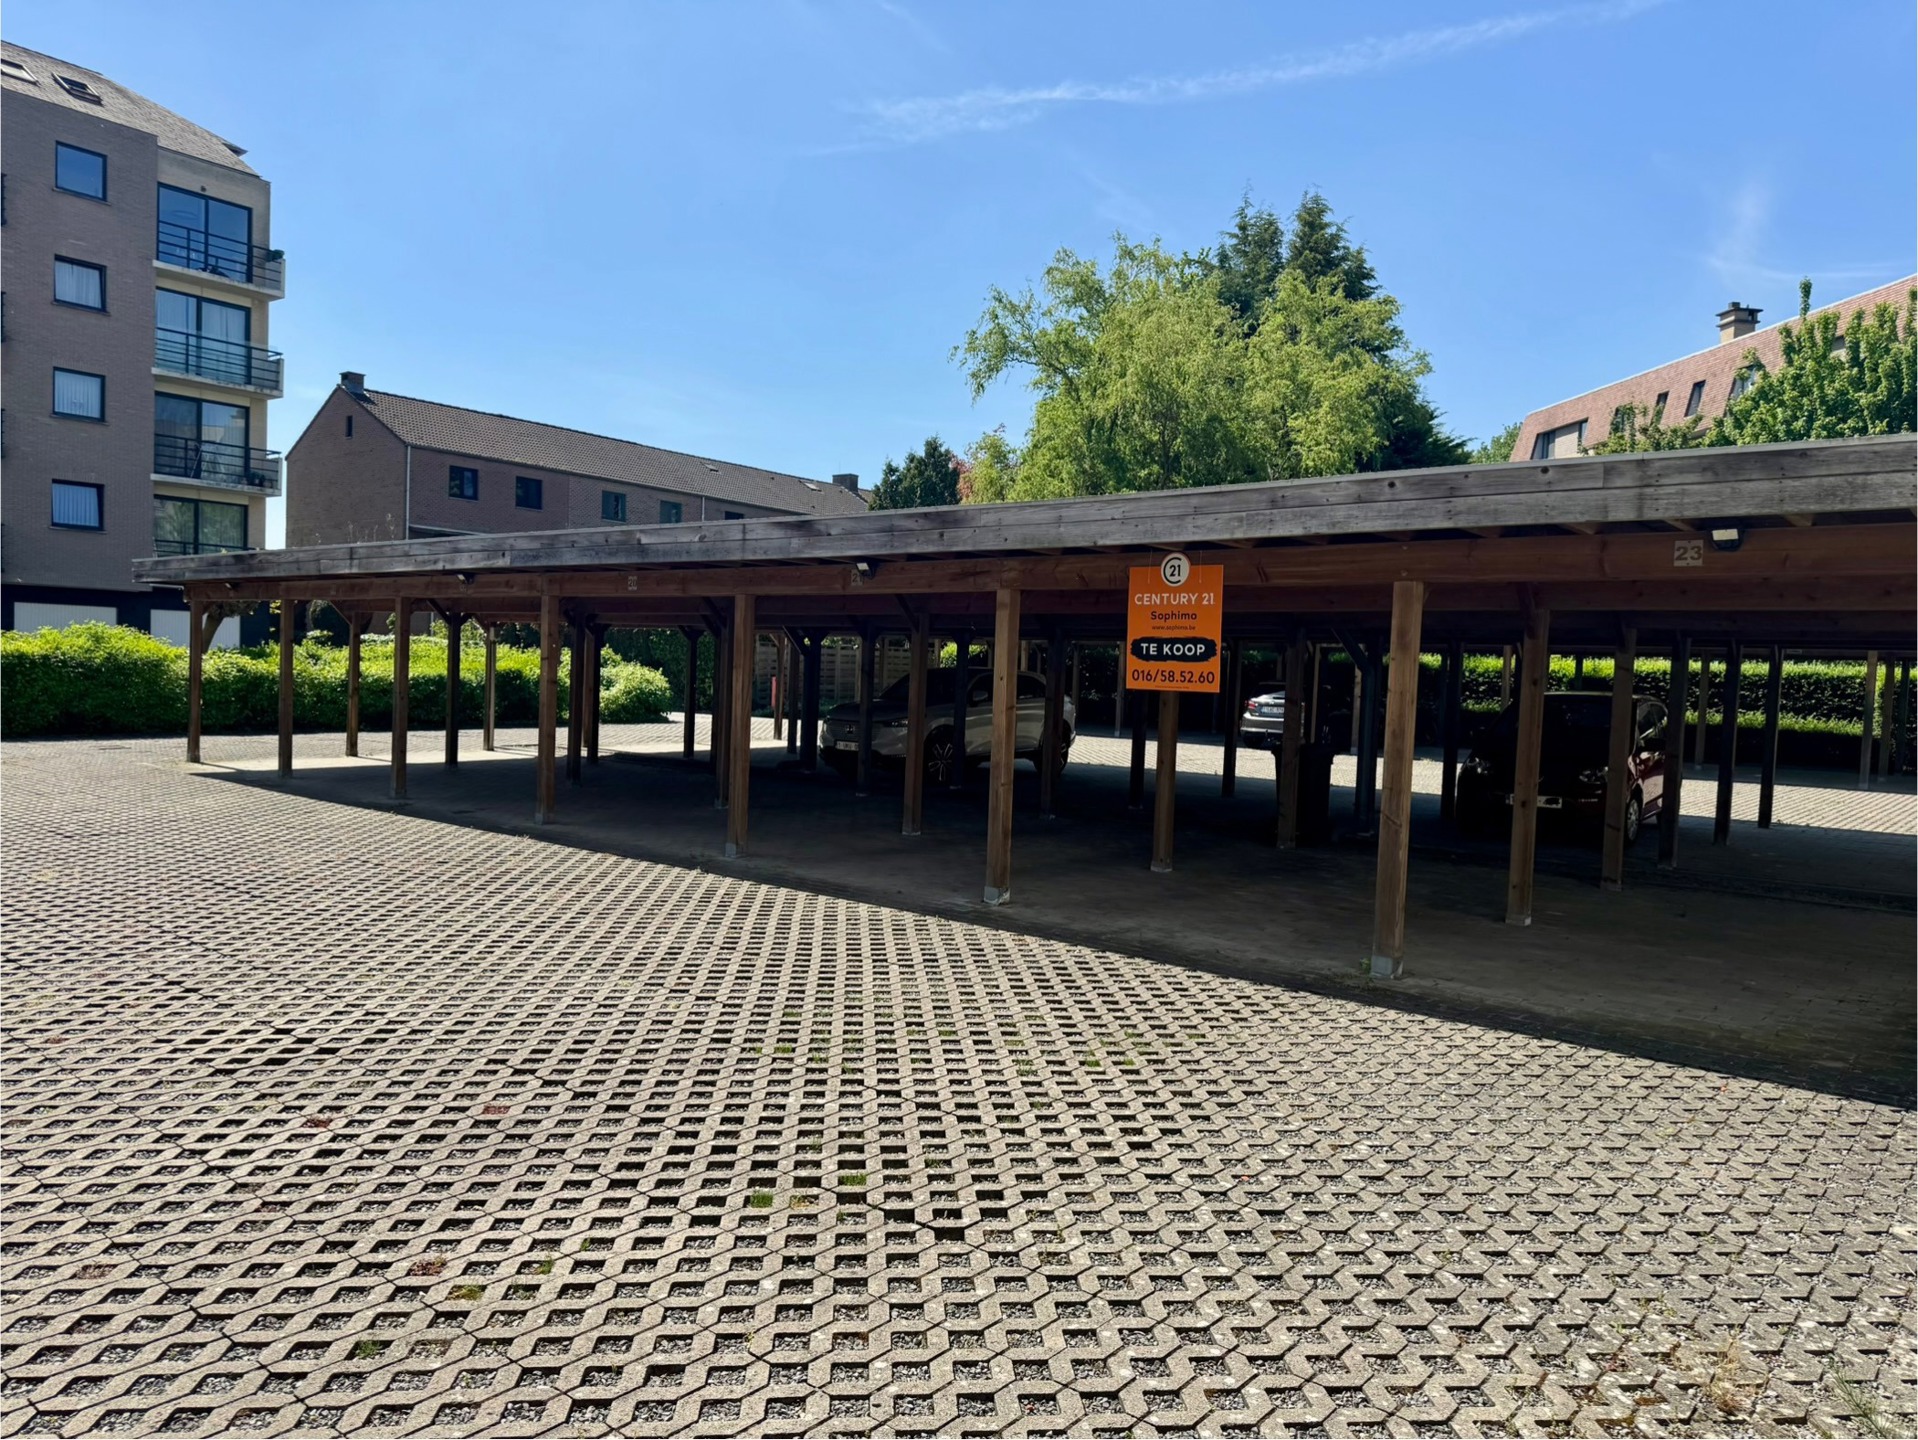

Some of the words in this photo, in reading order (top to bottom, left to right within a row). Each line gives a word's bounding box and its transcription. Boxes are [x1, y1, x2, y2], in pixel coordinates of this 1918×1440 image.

[1675, 546, 1702, 561] 23
[1134, 593, 1199, 605] CENTURY
[1150, 611, 1197, 622] Sophimo
[1140, 643, 1158, 655] TE
[1163, 643, 1206, 656] KOOP
[1131, 669, 1215, 684] 016/58.52.60
